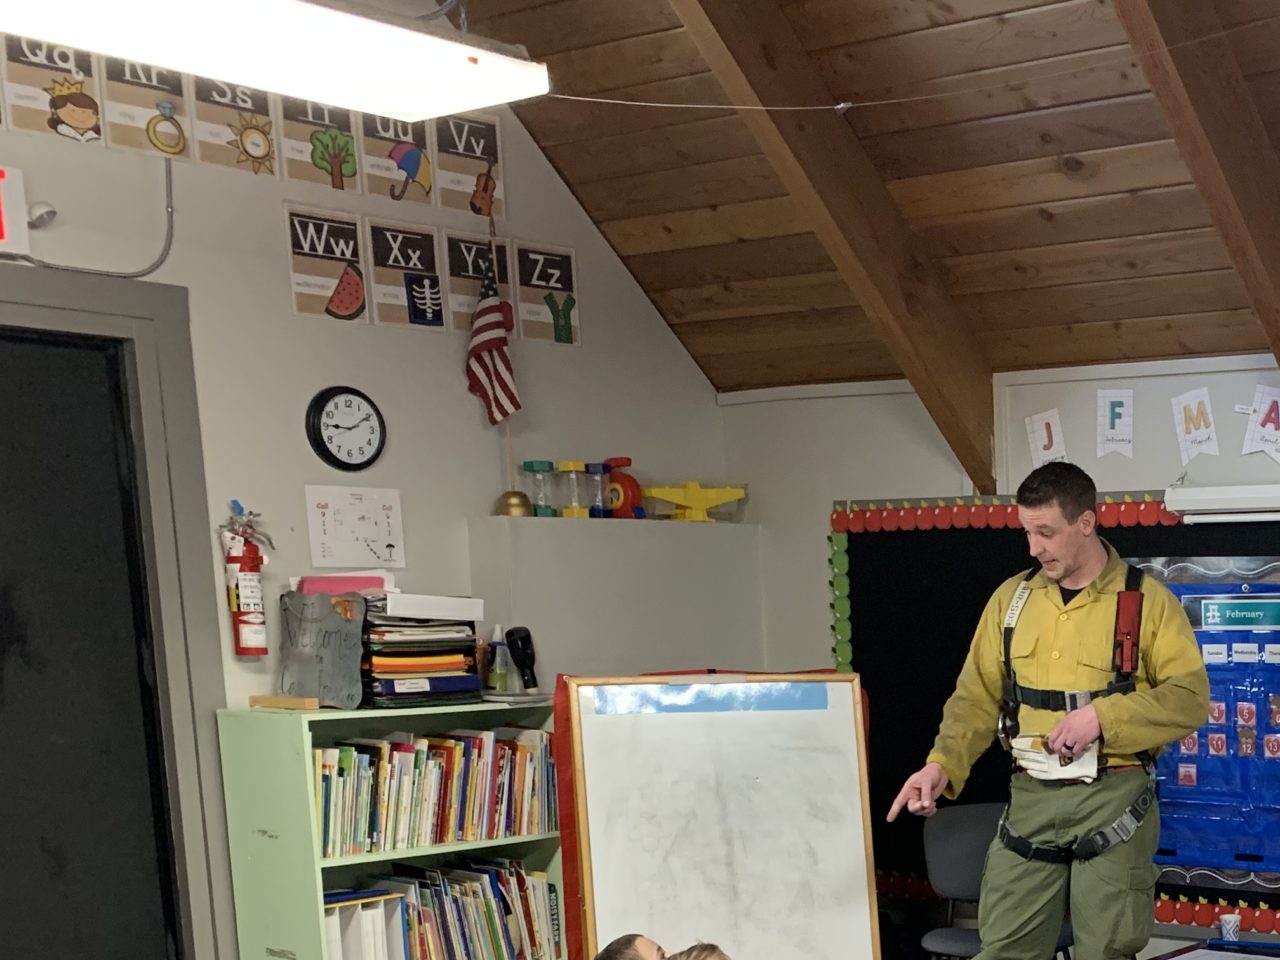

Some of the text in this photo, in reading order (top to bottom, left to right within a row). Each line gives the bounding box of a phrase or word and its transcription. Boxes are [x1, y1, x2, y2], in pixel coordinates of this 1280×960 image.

[449, 119, 484, 157] Vv
[293, 218, 355, 258] Ww
[384, 231, 424, 269] Xx
[528, 253, 563, 288] Zz
[1108, 400, 1124, 430] F
[1183, 399, 1211, 435] M
[1259, 400, 1280, 431] A
[1225, 608, 1264, 620] February
